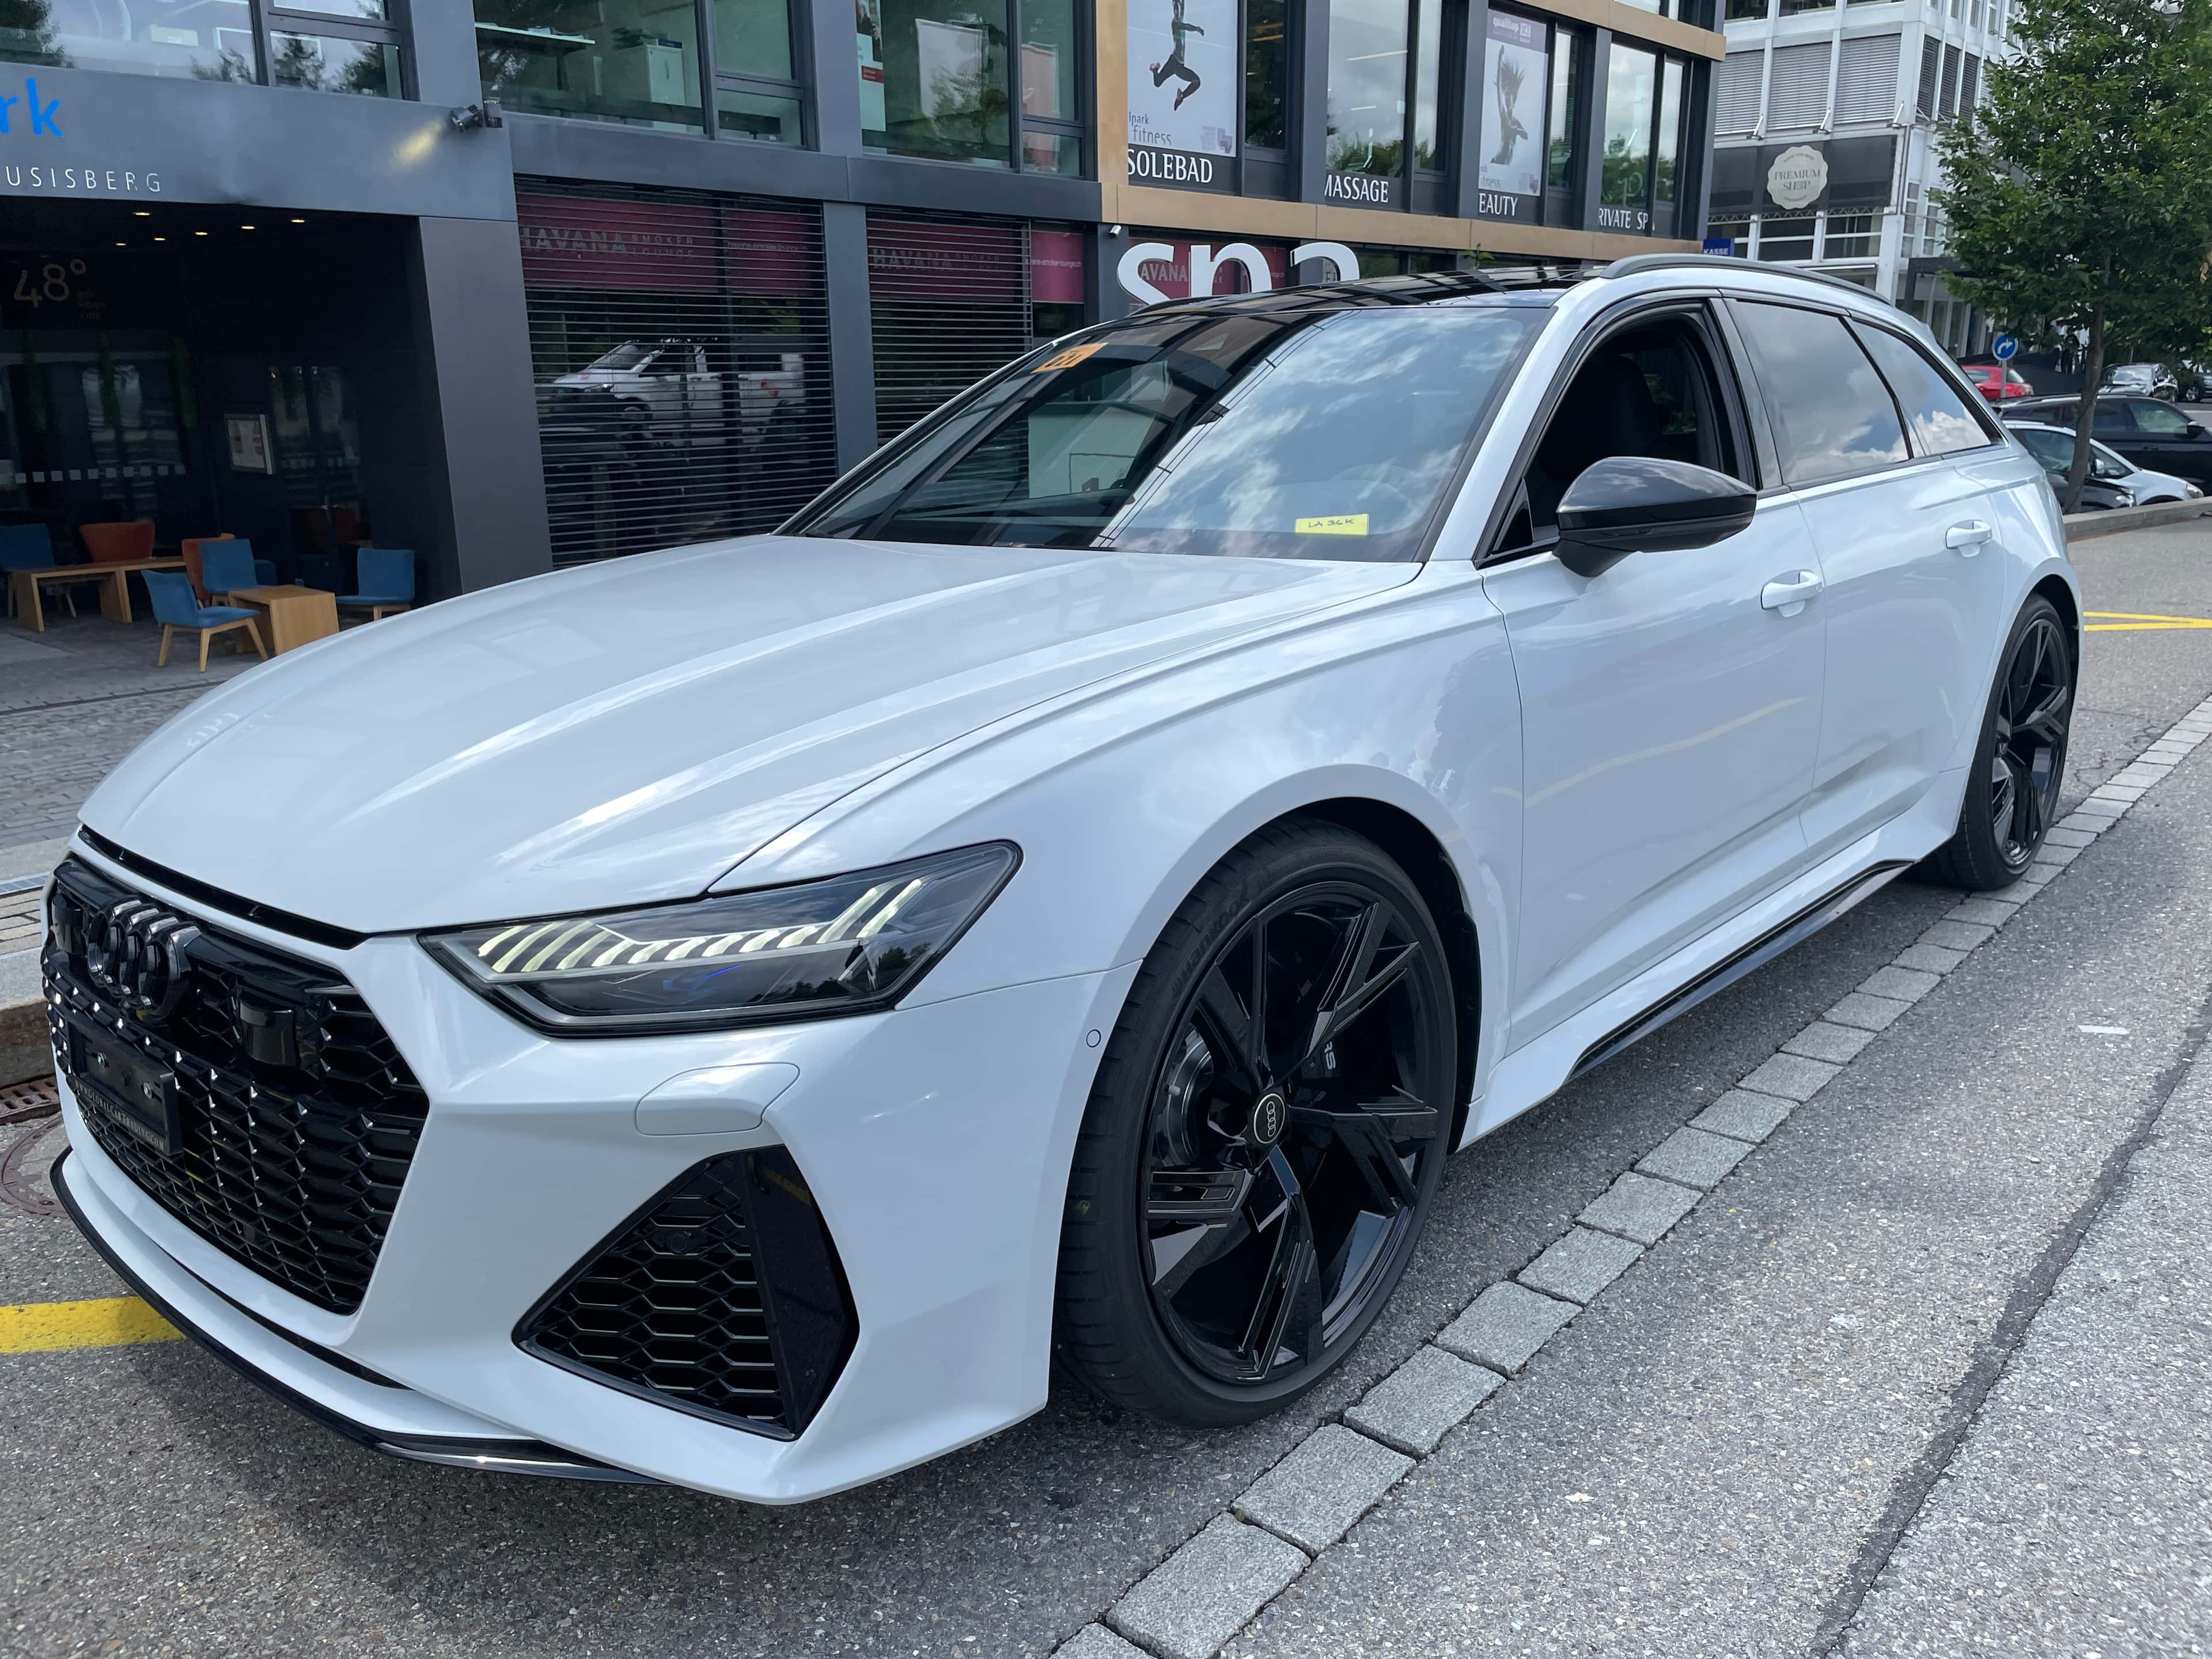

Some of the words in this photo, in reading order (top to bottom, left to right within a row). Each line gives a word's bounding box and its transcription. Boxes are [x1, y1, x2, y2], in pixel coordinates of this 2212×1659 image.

[1133, 124, 1172, 145] fitness
[1127, 149, 1213, 183] SOLEBAD
[1774, 168, 1821, 180] PREMIUM
[5, 165, 161, 192] USISBERG
[1637, 211, 1656, 231] SP
